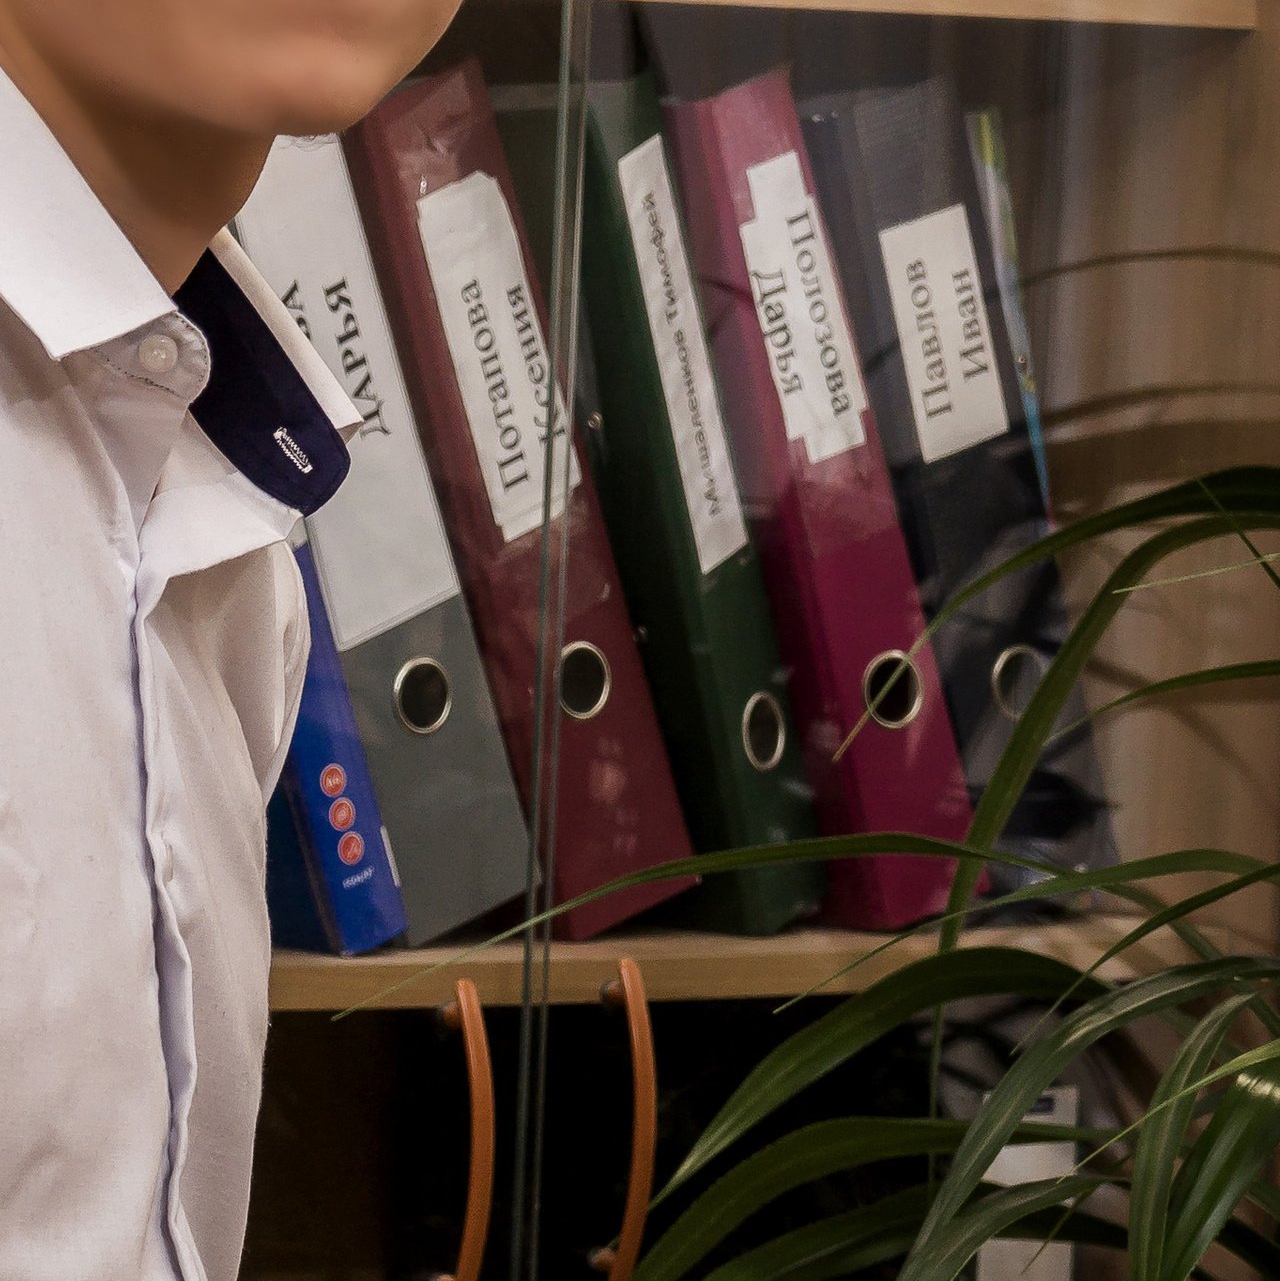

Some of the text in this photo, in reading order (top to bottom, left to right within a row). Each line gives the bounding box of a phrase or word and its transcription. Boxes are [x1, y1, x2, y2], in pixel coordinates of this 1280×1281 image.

[322, 275, 392, 442] ДАРЬЯ
[460, 278, 531, 494] Потапова
[505, 282, 569, 446] Ксения
[751, 267, 804, 397] Дарья
[785, 209, 853, 418] Полозова
[905, 258, 955, 422] Павлов
[951, 268, 989, 383] Иван
